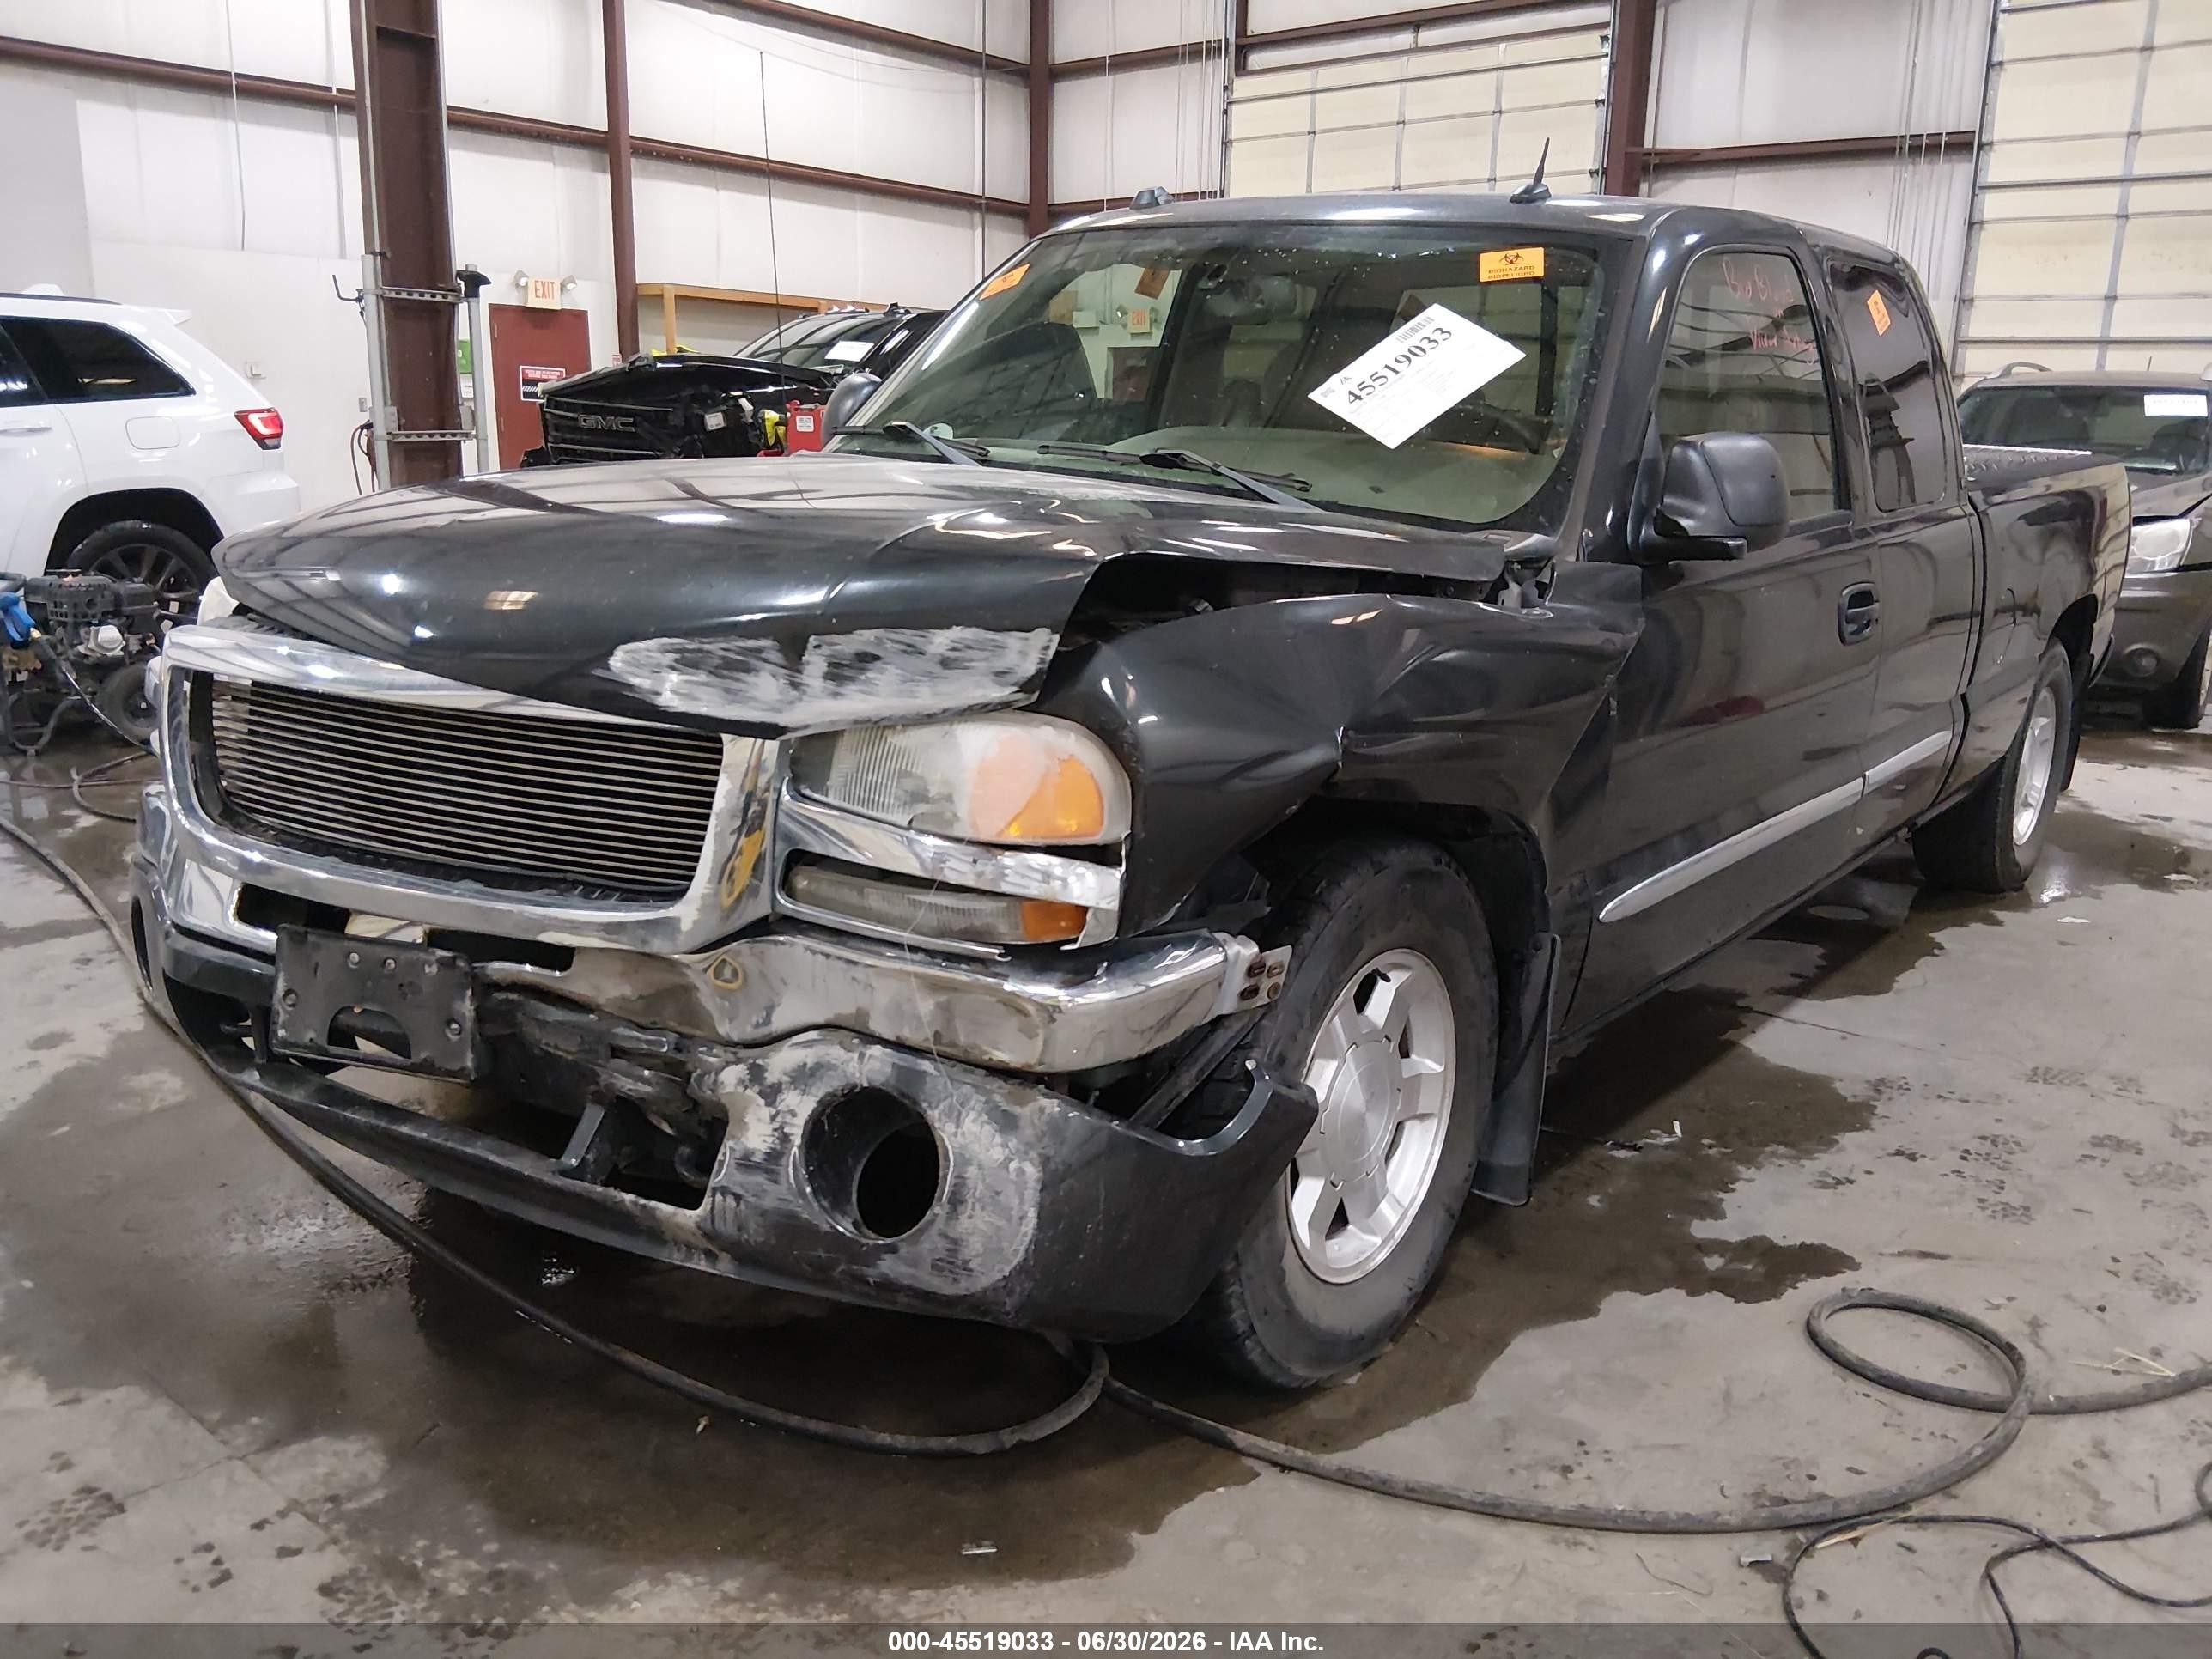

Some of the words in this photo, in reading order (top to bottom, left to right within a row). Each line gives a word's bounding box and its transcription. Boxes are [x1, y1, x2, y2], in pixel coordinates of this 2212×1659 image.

[1488, 265, 1535, 274] BIOHAZARD
[534, 280, 556, 300] EXIT
[1346, 326, 1453, 405] 45519033
[578, 414, 635, 432] GMC
